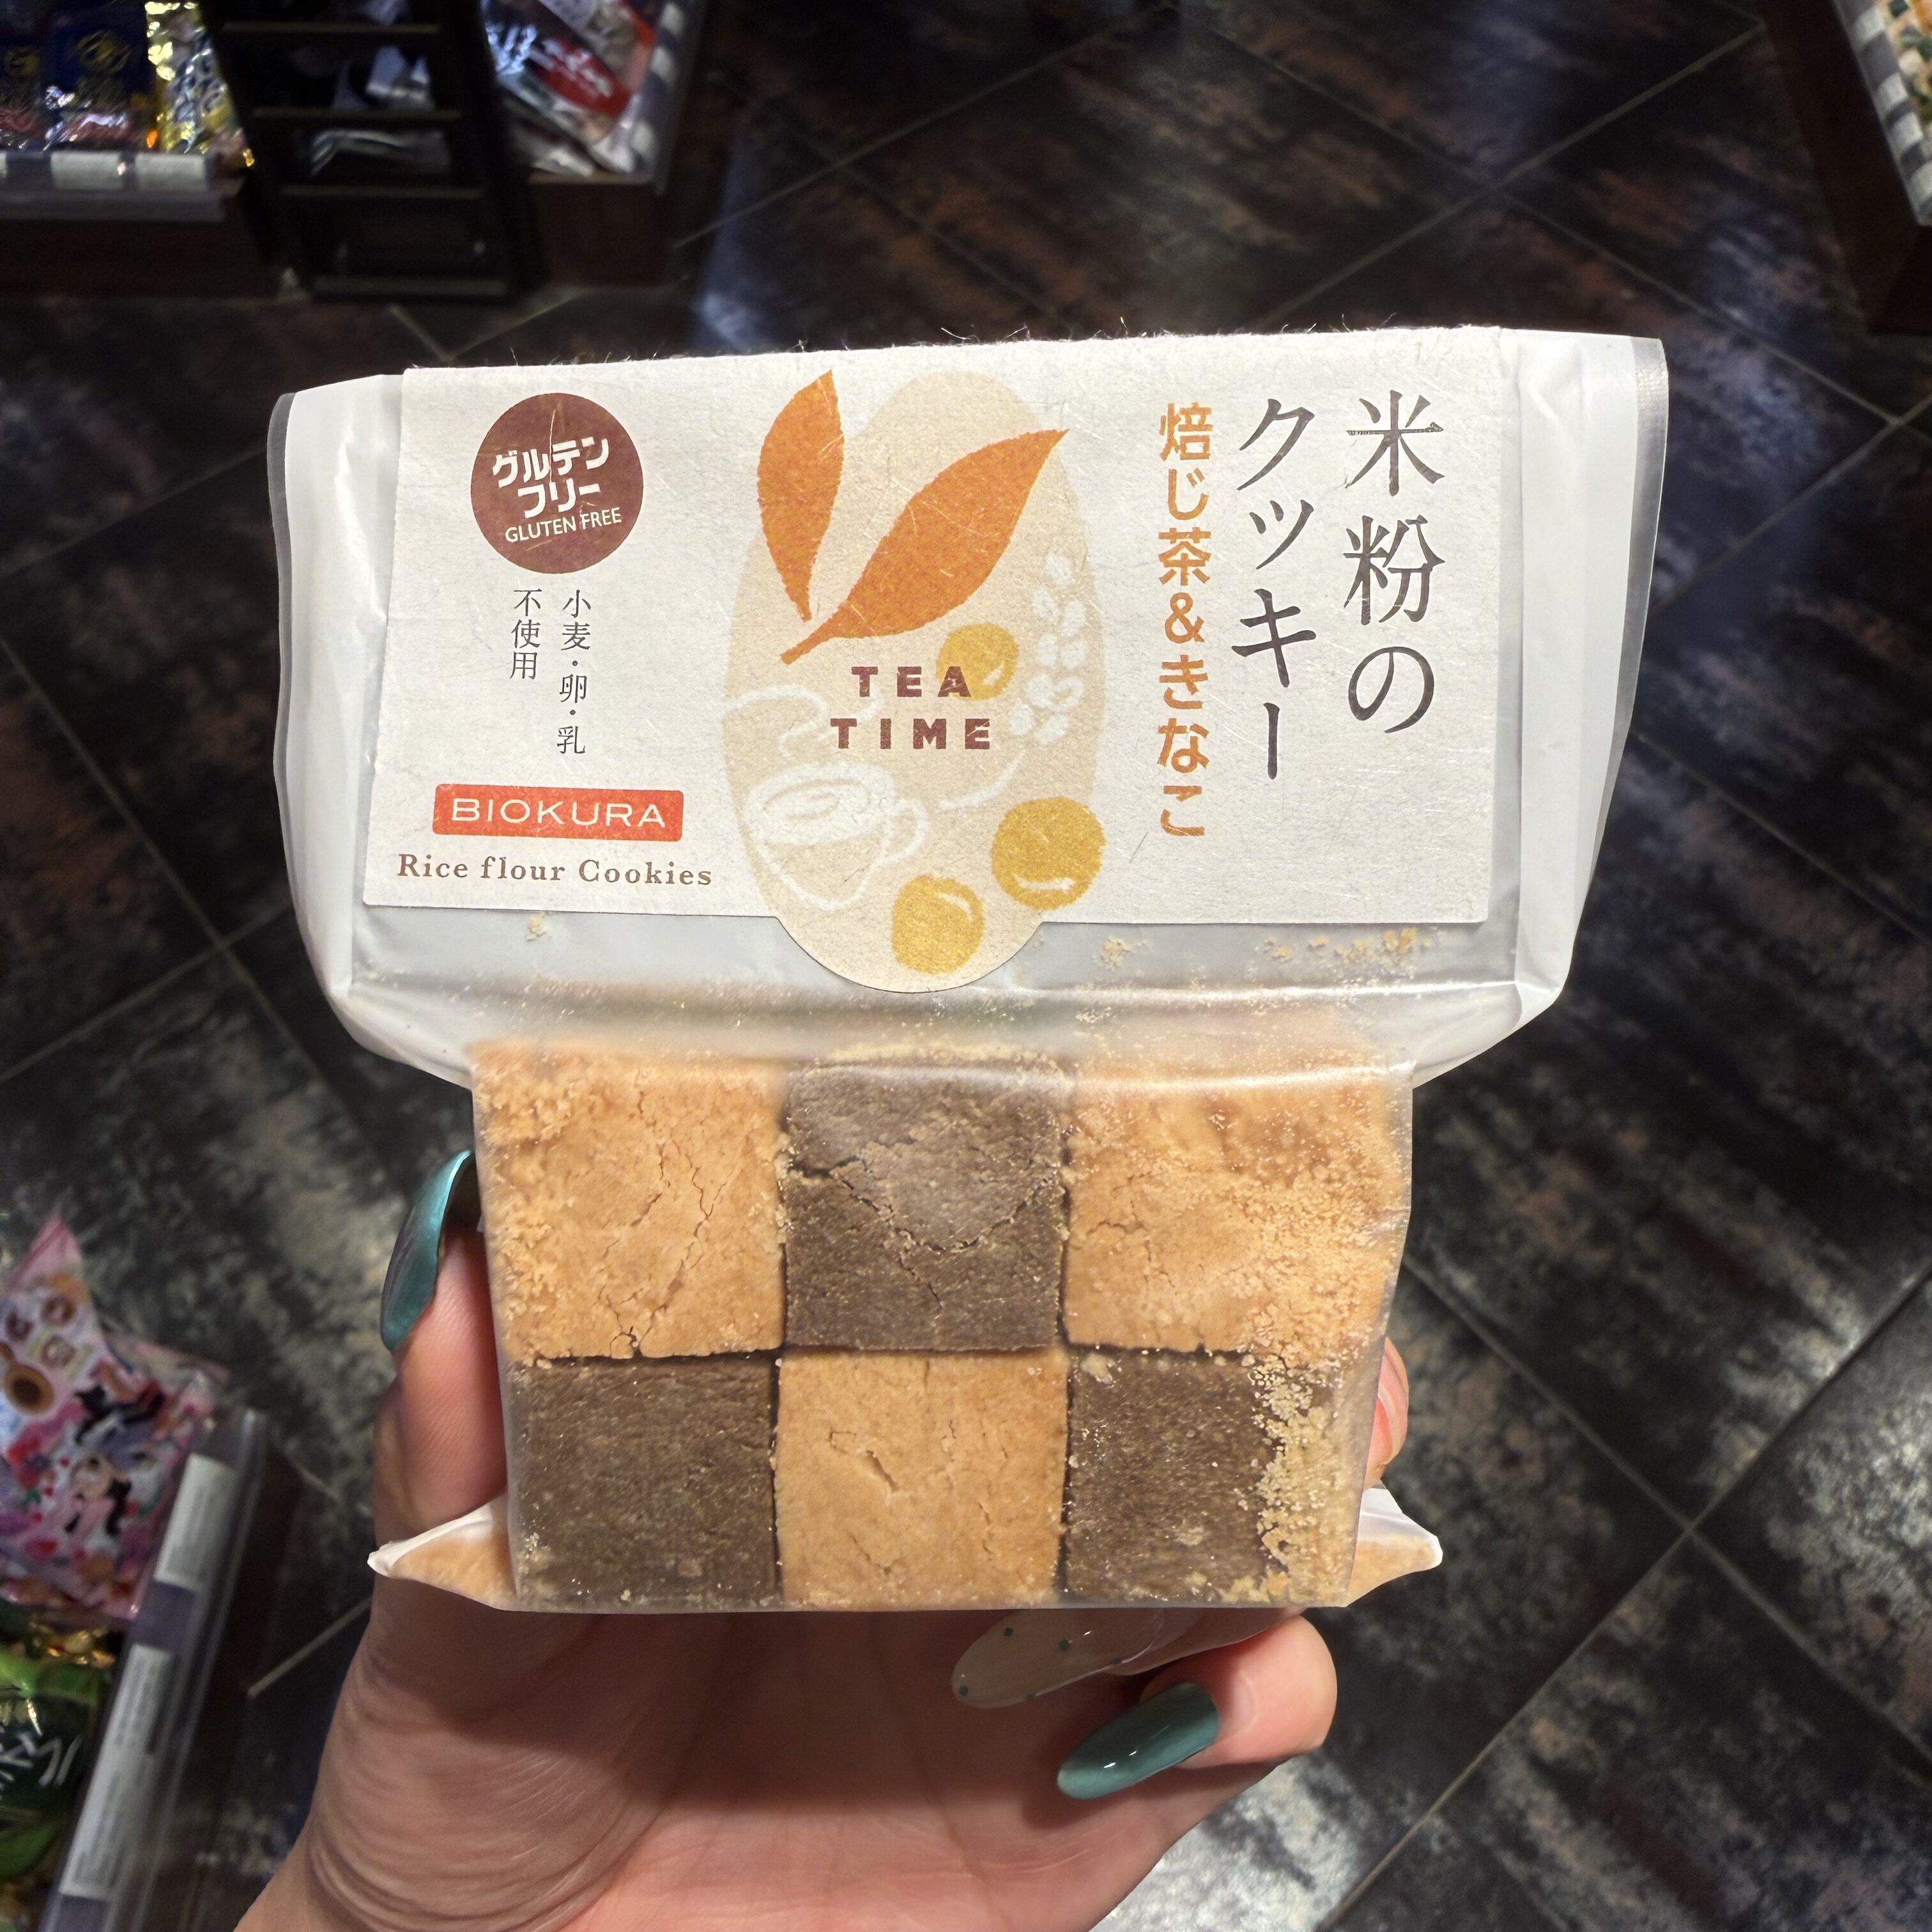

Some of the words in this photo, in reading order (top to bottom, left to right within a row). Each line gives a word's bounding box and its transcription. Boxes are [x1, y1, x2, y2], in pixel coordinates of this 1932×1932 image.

[492, 436, 610, 488] グルテン
[518, 478, 601, 519] フリー
[505, 516, 576, 543] GLUTEN
[580, 507, 622, 530] FREE
[1344, 390, 1445, 733] 米粉の
[1231, 398, 1317, 780] クッキー
[509, 588, 542, 680] 不使用
[1156, 402, 1214, 837] 焙じ茶&きなこ
[556, 589, 591, 754] 小麦・卵・乳
[851, 666, 972, 698] TEA
[830, 717, 990, 749] TIME
[451, 798, 665, 828] BIOKURA
[397, 853, 469, 878] Rice
[480, 856, 565, 882] flour
[578, 859, 712, 886] Cookies
